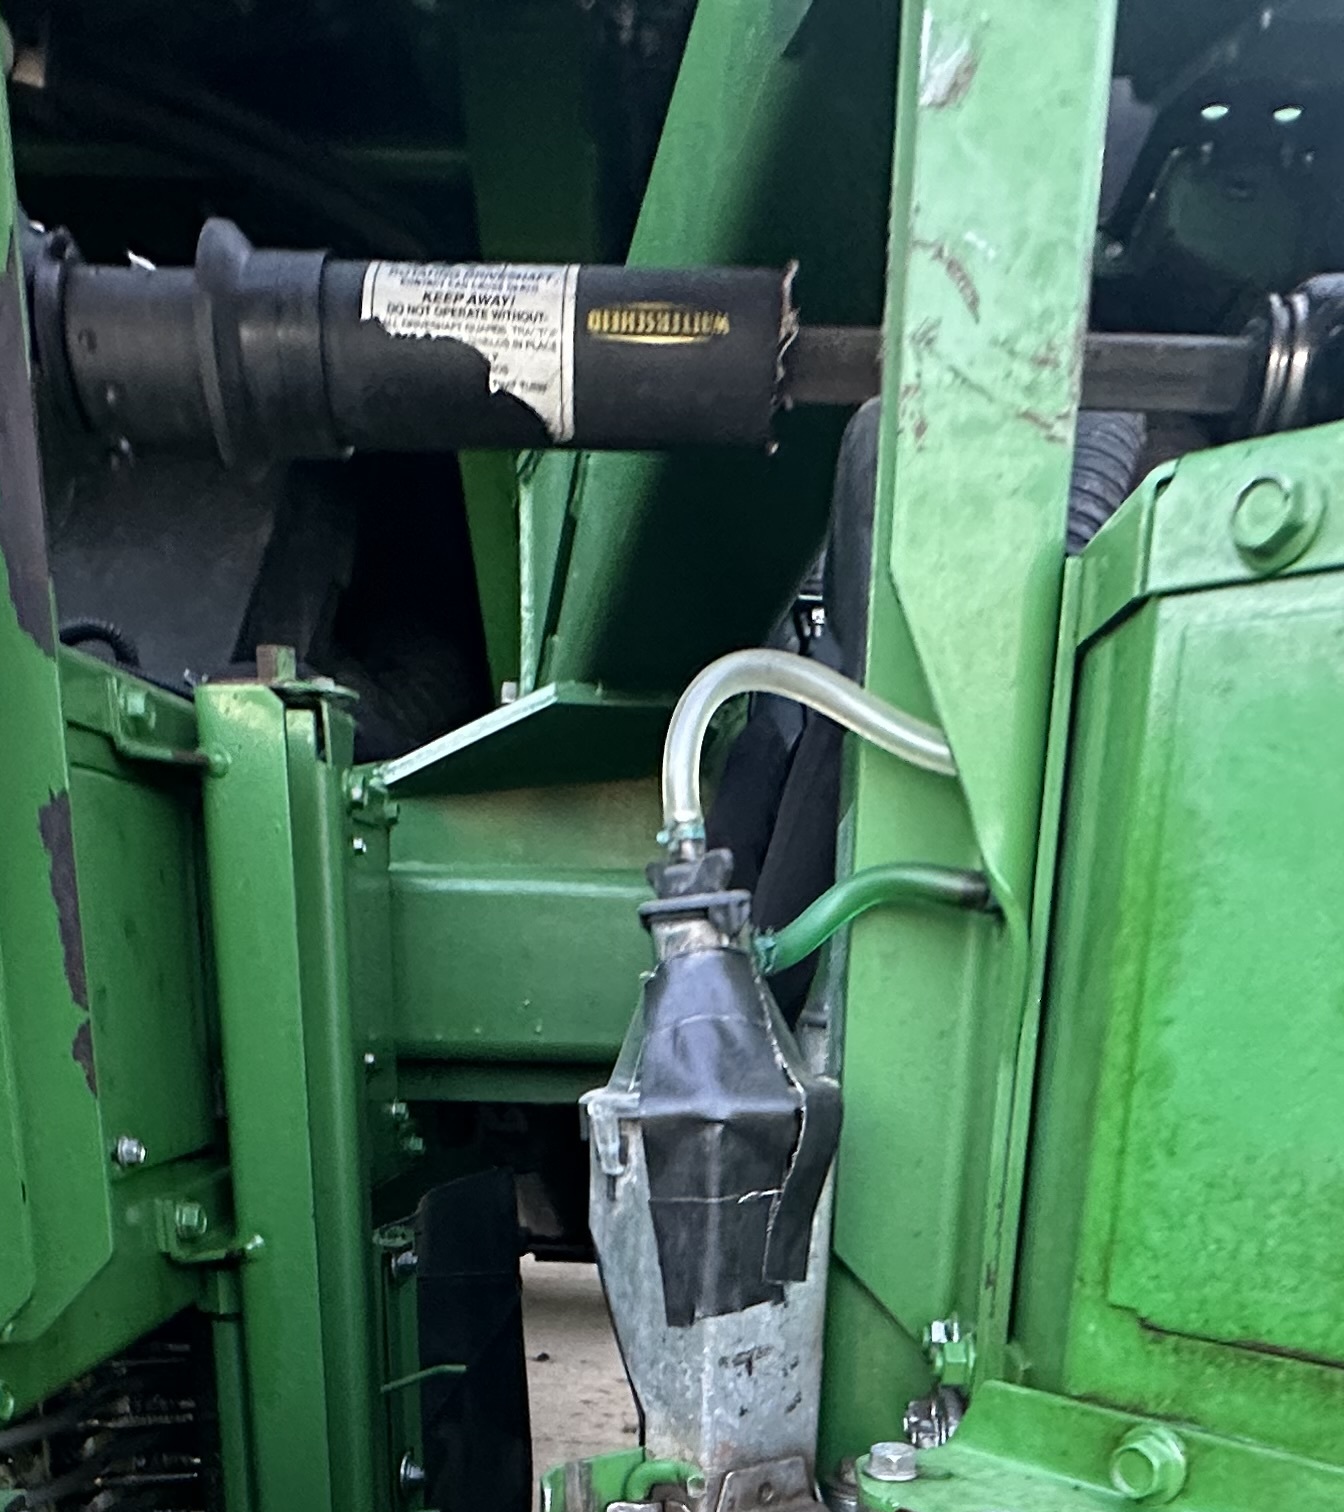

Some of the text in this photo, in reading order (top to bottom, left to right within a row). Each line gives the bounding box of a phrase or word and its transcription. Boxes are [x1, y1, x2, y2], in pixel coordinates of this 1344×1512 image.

[422, 291, 465, 303] KEEP
[387, 301, 405, 315] DO
[406, 303, 431, 316] NOT
[434, 304, 489, 319] OPERATE
